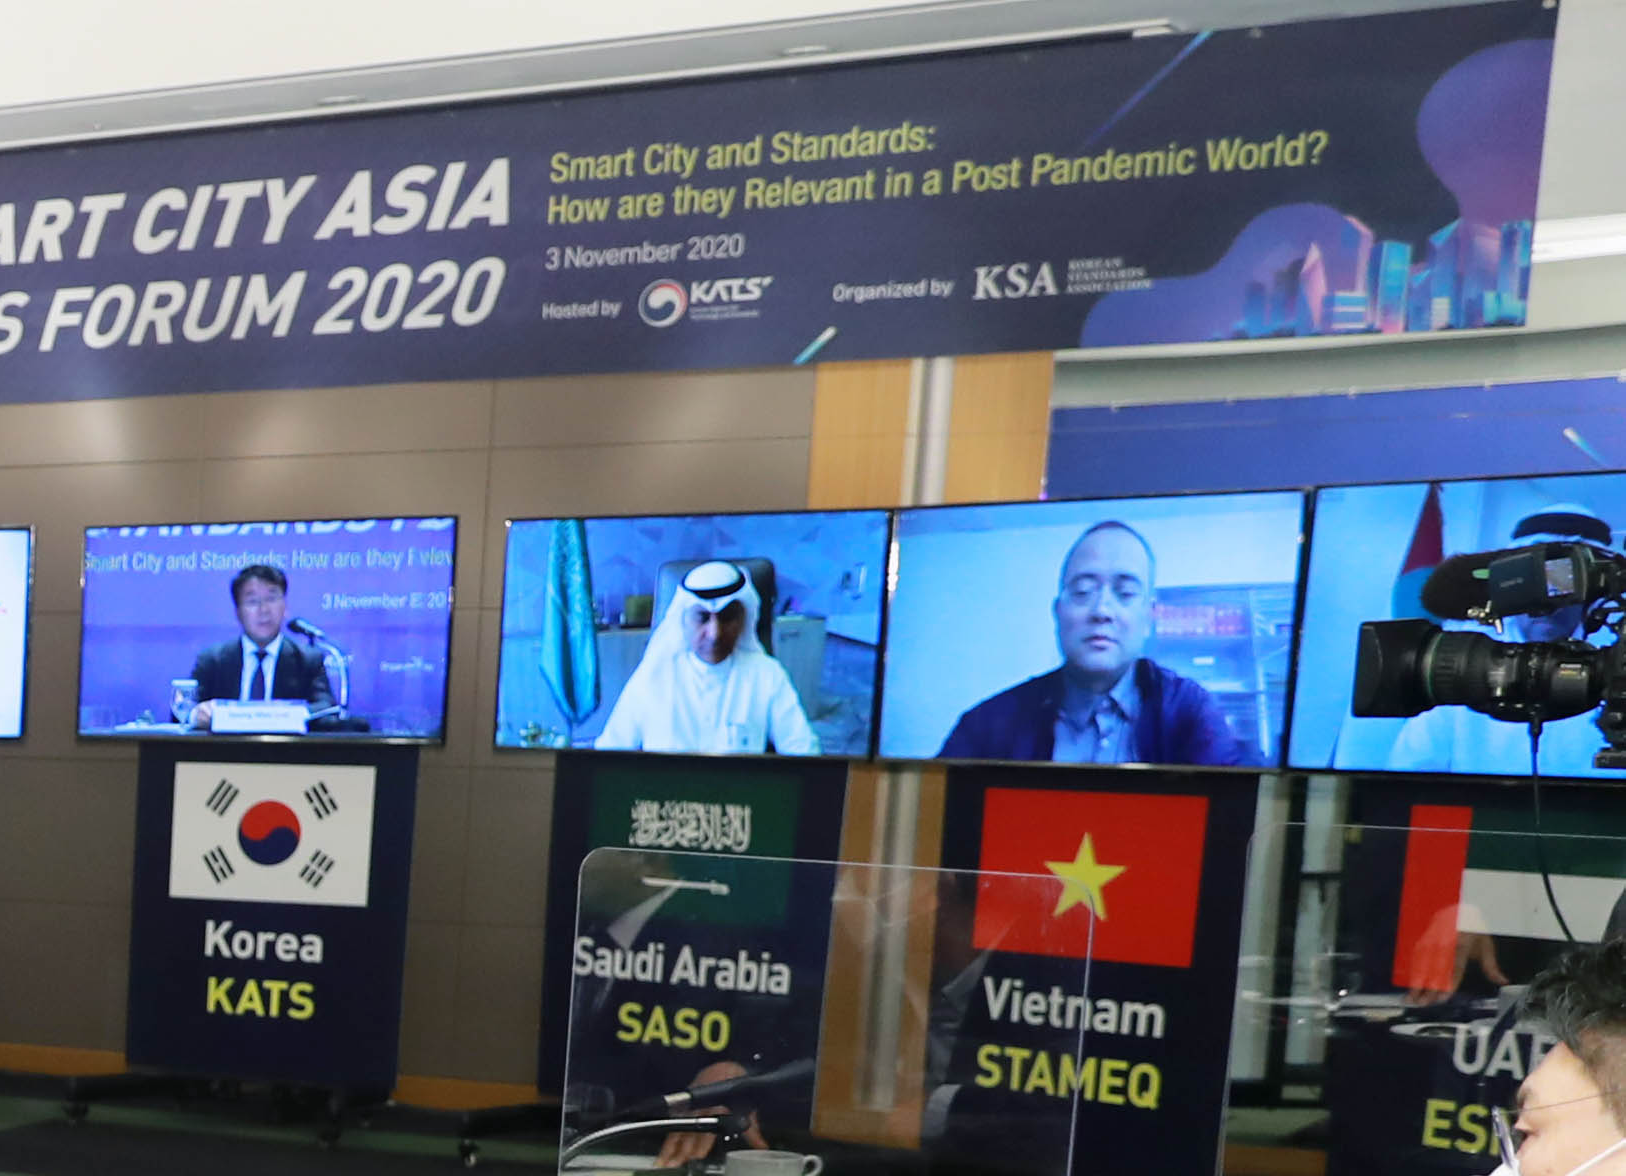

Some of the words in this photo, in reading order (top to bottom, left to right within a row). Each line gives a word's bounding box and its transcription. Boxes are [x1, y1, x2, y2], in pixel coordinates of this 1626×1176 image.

[550, 150, 635, 183] Smart
[644, 143, 698, 179] City
[706, 135, 762, 170] and
[771, 121, 937, 165] Standards:
[547, 195, 609, 225] How
[617, 191, 664, 219] are
[673, 184, 735, 220] they
[744, 169, 876, 210] Relevant
[884, 167, 912, 198] in
[922, 168, 941, 196] a
[952, 158, 1022, 193] Post
[1030, 142, 1197, 186] Pandemic
[1206, 130, 1329, 171] World?
[134, 174, 317, 254] CITY
[314, 158, 511, 240] ASIA
[545, 247, 561, 271] 3
[564, 239, 683, 269] November
[687, 233, 745, 261] 2020
[39, 272, 306, 353] FORUM
[313, 256, 507, 335] 2020
[833, 280, 926, 304] Organized
[930, 277, 954, 298] by
[972, 262, 1059, 300] KSA
[541, 301, 597, 320] Hosted
[600, 299, 621, 318] by
[132, 551, 161, 574] City
[166, 550, 196, 570] and
[292, 550, 330, 569] How
[334, 552, 360, 568] are
[366, 547, 399, 571] they
[333, 592, 406, 610] November
[204, 919, 323, 964] Korea
[573, 936, 665, 984] Saudi
[670, 945, 791, 996] Arabia
[207, 976, 316, 1020] KATS
[984, 975, 1166, 1039] Vietnam
[616, 1002, 731, 1052] SASO
[975, 1044, 1161, 1109] STAMEQ
